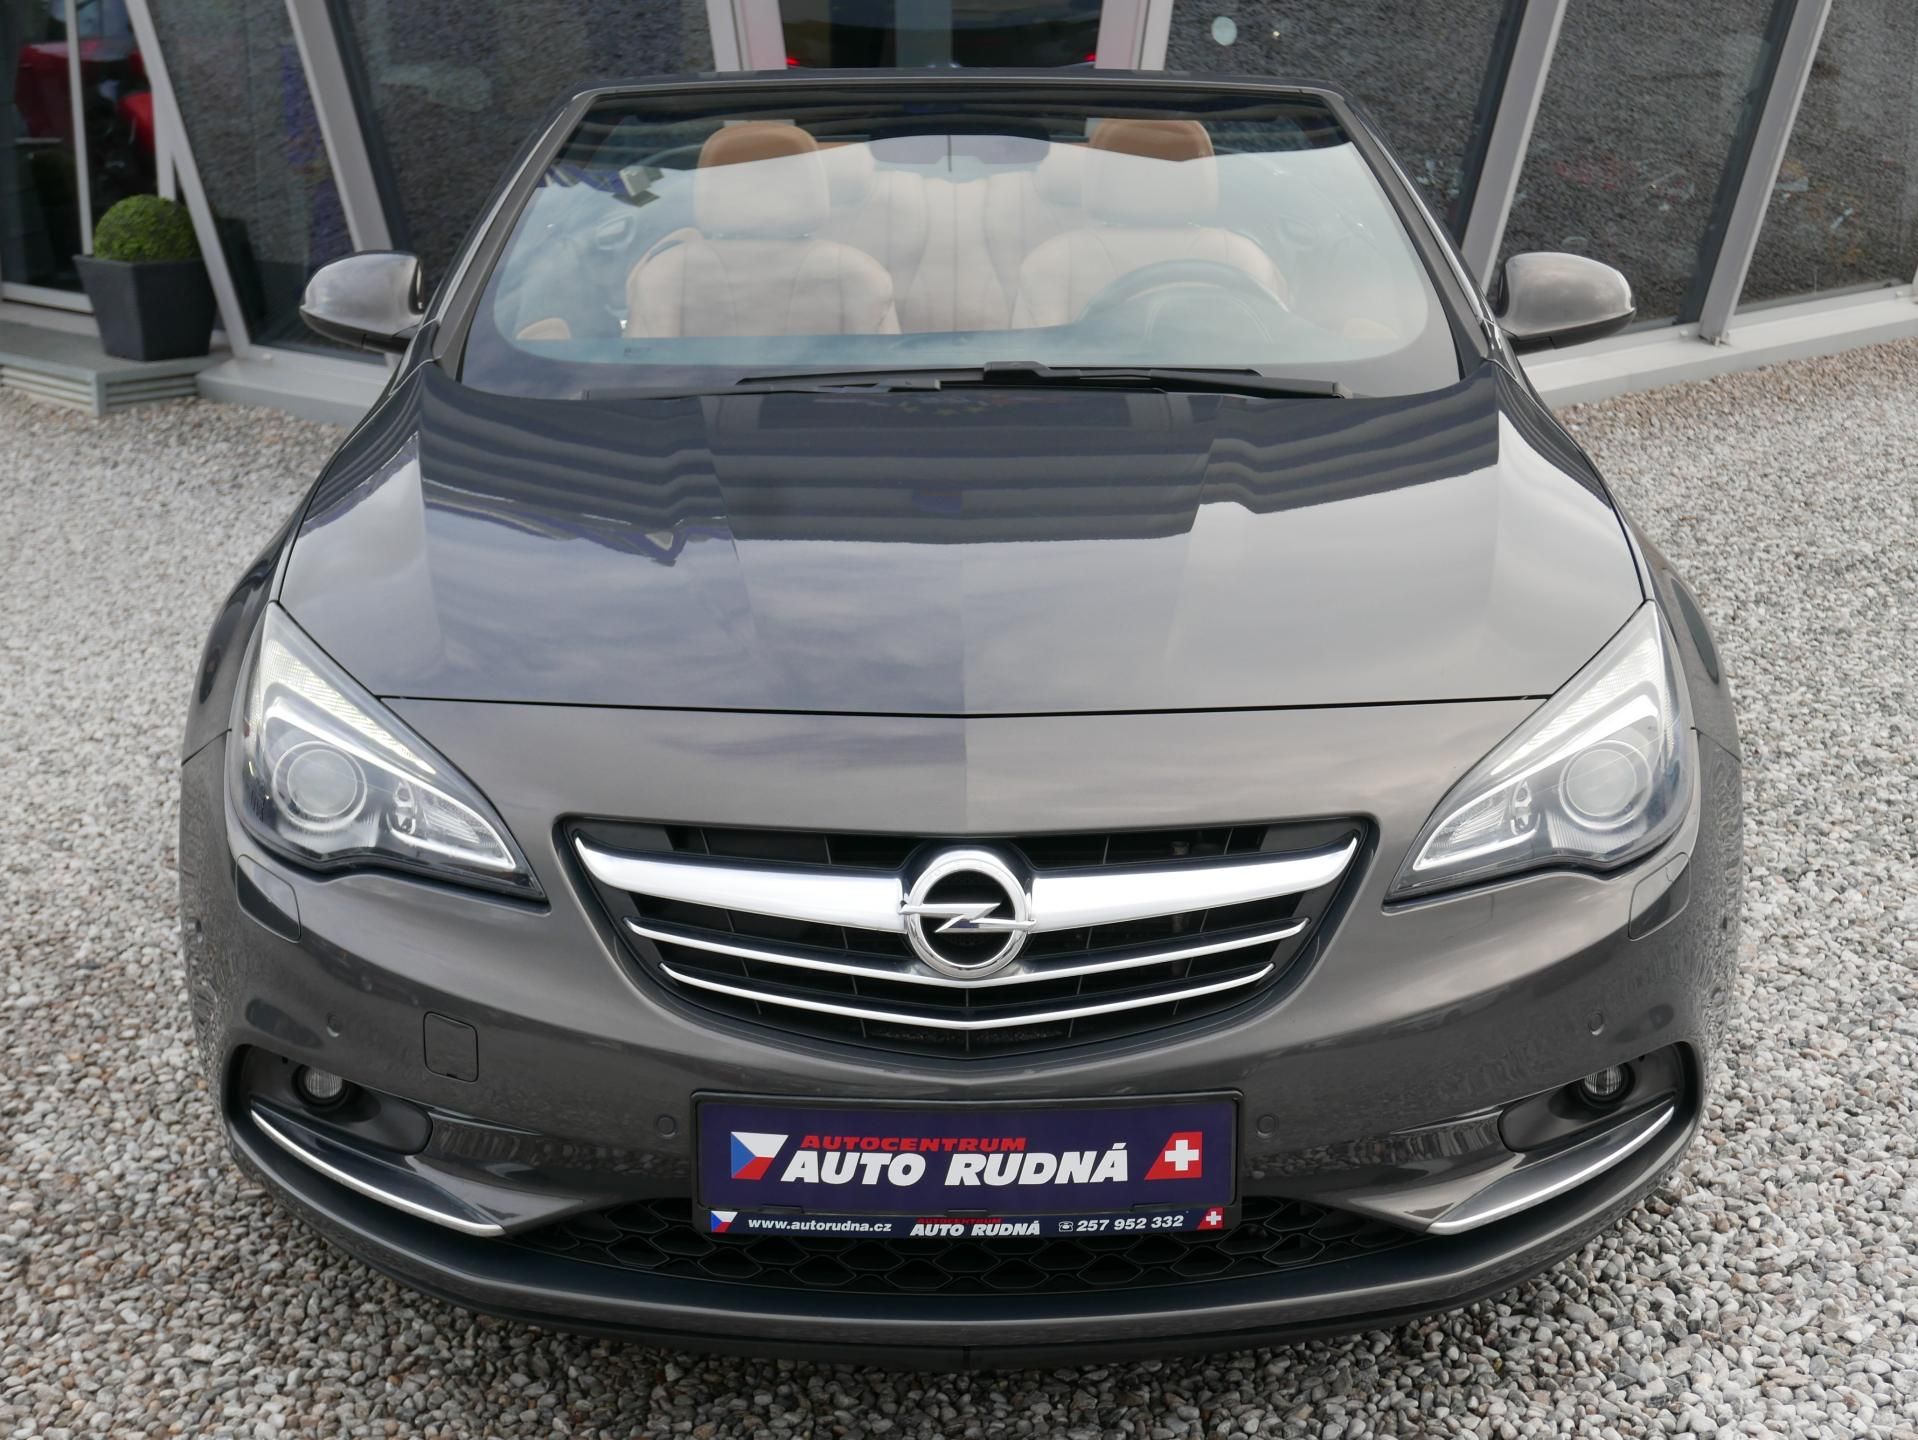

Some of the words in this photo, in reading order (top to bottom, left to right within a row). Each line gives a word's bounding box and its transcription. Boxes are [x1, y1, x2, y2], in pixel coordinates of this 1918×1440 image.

[801, 1135, 1027, 1152] AUTOCENTRUM
[780, 1150, 926, 1187] AUTO
[944, 1142, 1128, 1186] RUDNÁ
[748, 1218, 893, 1232] www.autorudna.cz
[909, 1223, 965, 1236] AUTO
[970, 1220, 1040, 1236] RUDNÁ
[1076, 1219, 1110, 1232] 257
[1113, 1217, 1147, 1230] 952
[1151, 1215, 1185, 1228] 332
